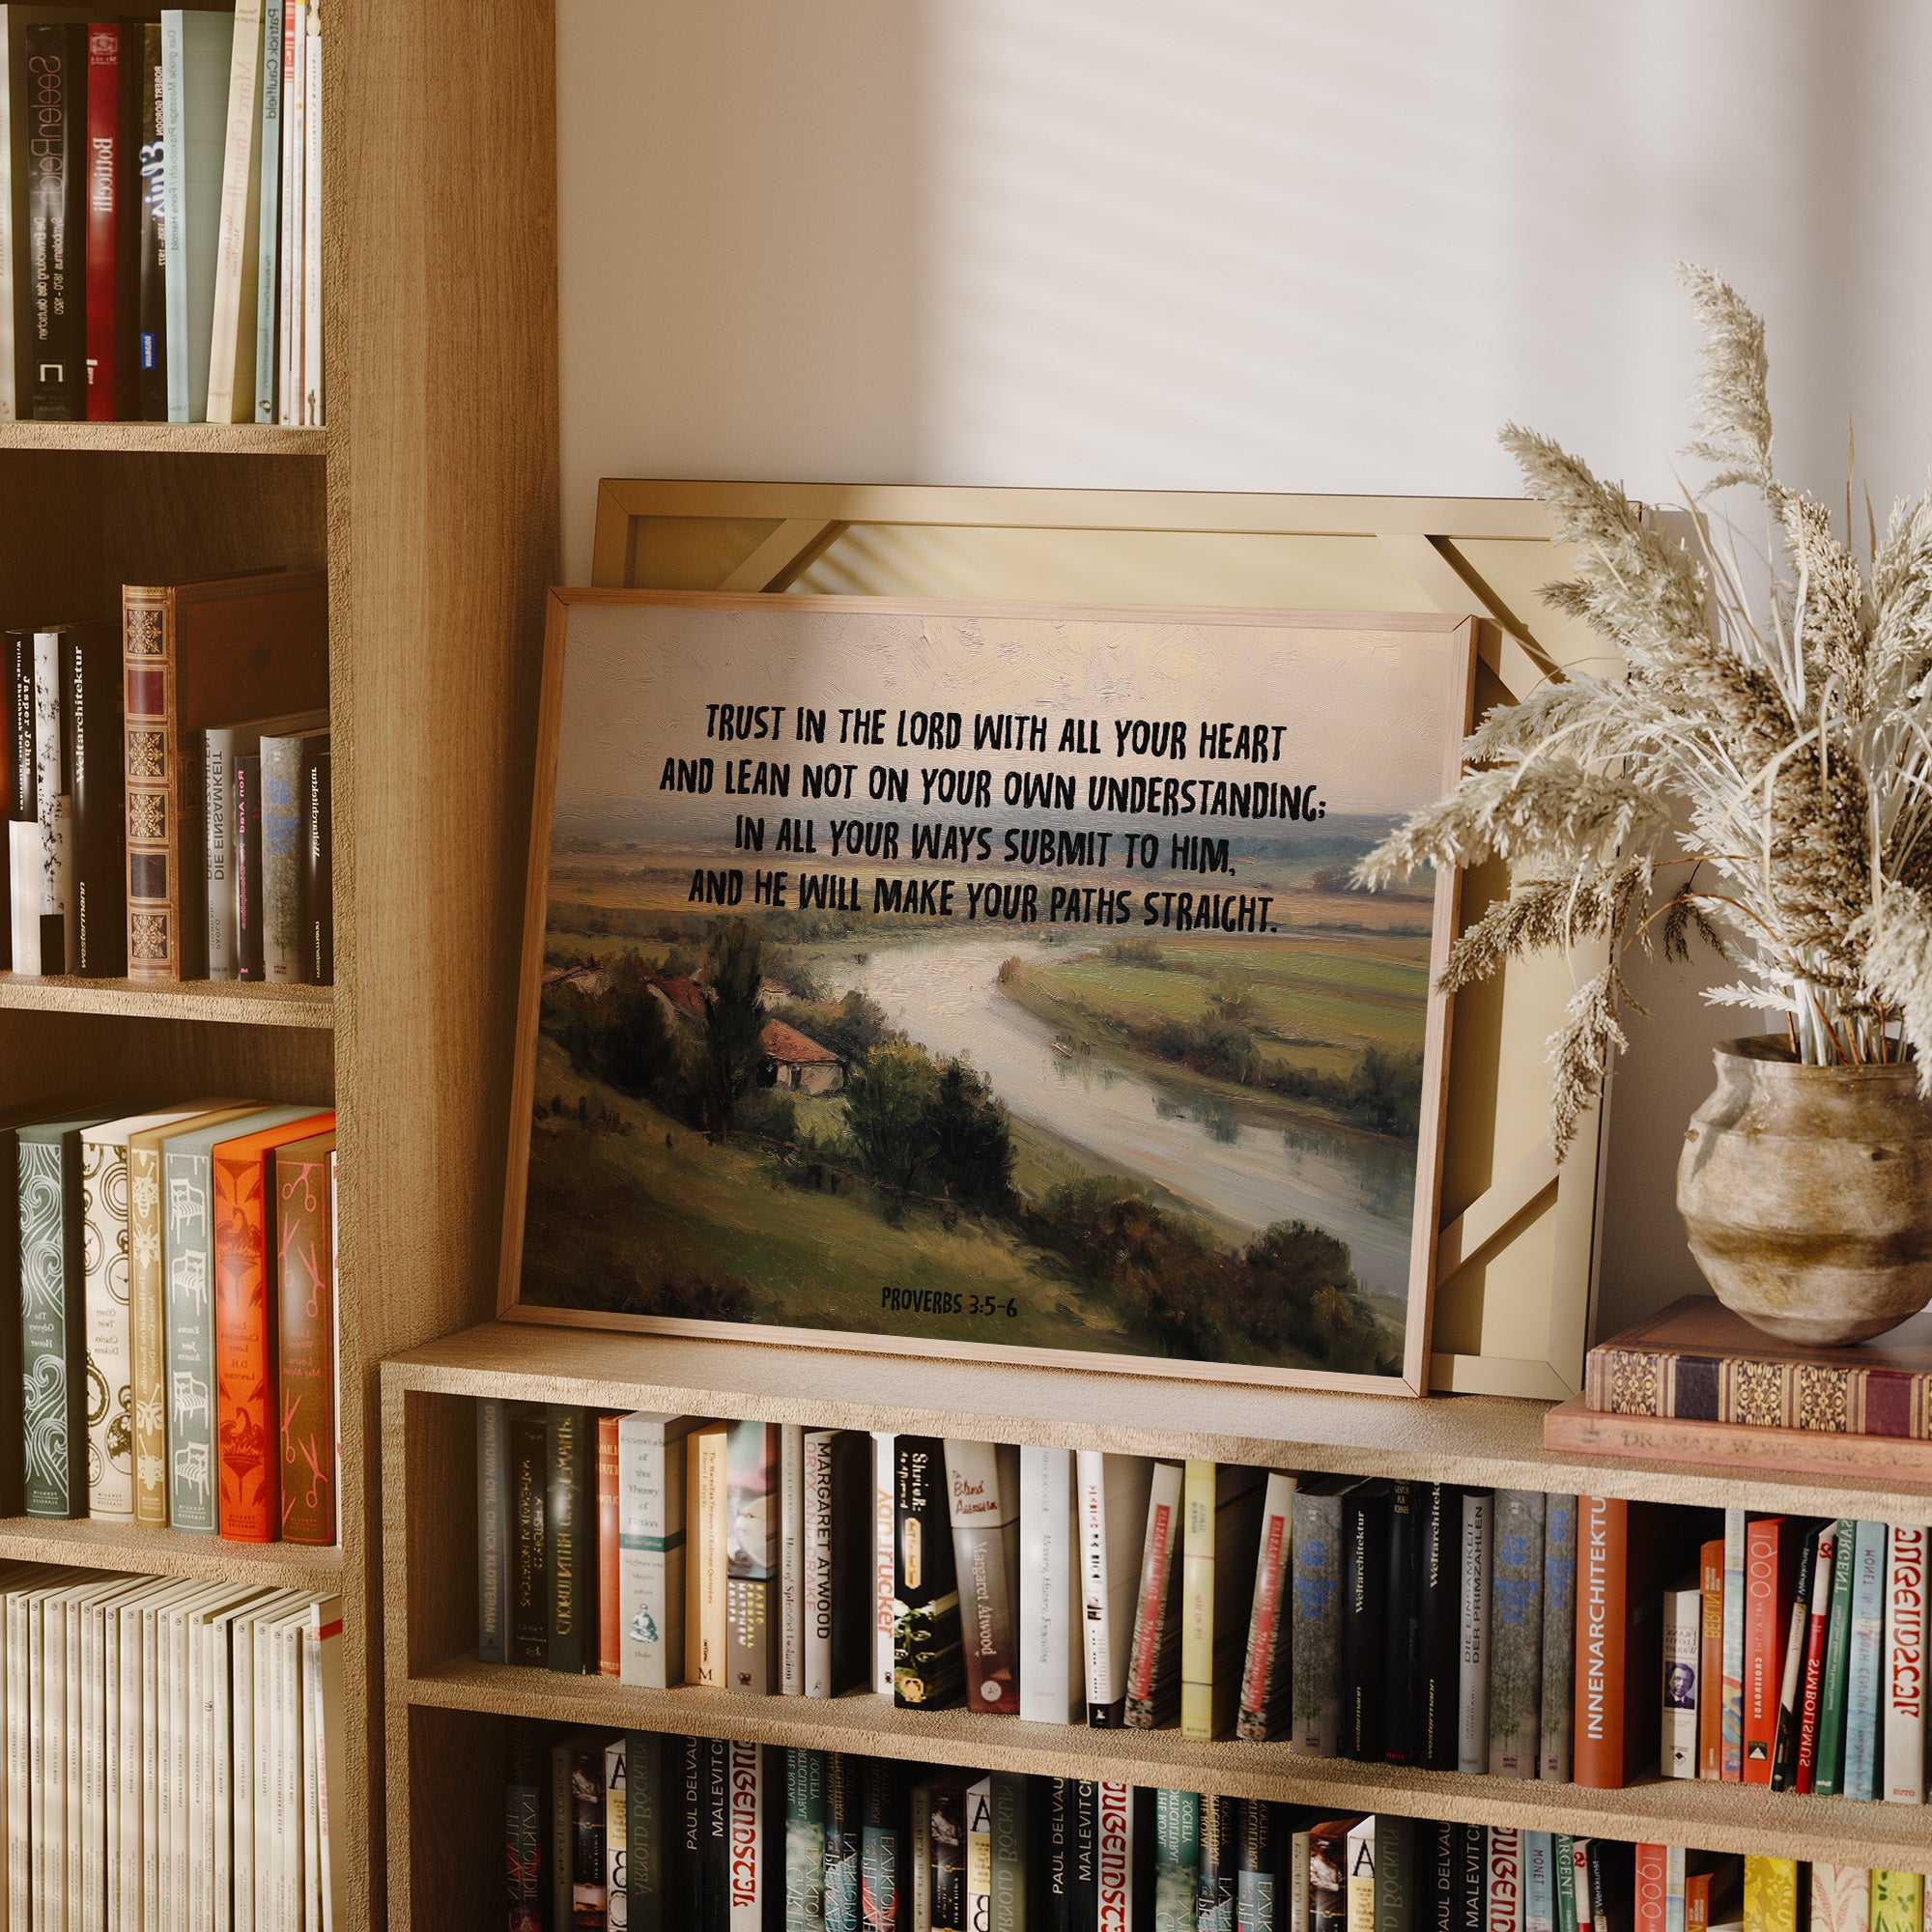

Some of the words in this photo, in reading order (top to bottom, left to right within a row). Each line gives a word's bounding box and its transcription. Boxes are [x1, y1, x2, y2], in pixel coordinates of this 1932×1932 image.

[22, 676, 31, 726] Jasper
[74, 645, 84, 783] Weltarchitektur
[706, 704, 785, 741] TRUST
[796, 707, 826, 744] IN
[838, 708, 887, 745] THE
[896, 709, 961, 750] LORD
[974, 714, 1047, 753] WITH
[1059, 718, 1101, 753] ALL
[1115, 721, 1186, 759] YOUR
[1199, 722, 1287, 763] HEART
[659, 757, 714, 794] AND
[724, 759, 790, 798] LEAN
[801, 763, 858, 799] NOT
[868, 765, 908, 803] ON
[922, 768, 991, 808] YOUR
[1004, 771, 1076, 810] OWN
[1088, 776, 1326, 822] UNDERSTANDING;
[735, 814, 764, 851] IN
[776, 817, 816, 853] ALL
[831, 819, 899, 860] YOUR
[912, 822, 992, 863] WAYS
[1004, 828, 1113, 867] SUBMIT
[1125, 833, 1158, 868] TO
[1171, 833, 1236, 876] HIM,
[688, 869, 743, 906] AND
[754, 869, 787, 907] HE
[799, 872, 862, 911] WILL
[873, 877, 955, 915] MAKE
[967, 882, 1037, 923] YOUR
[1050, 886, 1132, 924] PATHS
[1144, 891, 1277, 933] STRAIGHT.
[882, 1287, 962, 1314] PROVERBS
[969, 1294, 1018, 1318] 3:5-6
[485, 1405, 497, 1476] DOWNTOWN
[639, 1452, 647, 1463] of
[805, 1441, 817, 1489] ORYX
[485, 1479, 497, 1505] OWL
[629, 1486, 659, 1496] Theory
[636, 1469, 651, 1478] the
[817, 1442, 831, 1551] MARGARET
[485, 1510, 497, 1551] CHUCK
[628, 1518, 659, 1528] Fiction
[639, 1502, 648, 1511] of
[805, 1497, 817, 1541] AND
[805, 1550, 817, 1611] CRAKE
[972, 1541, 989, 1601] Margaret
[1355, 1511, 1365, 1613] Weltarchitektur
[1473, 1506, 1483, 1622] PRIMZAHLEN
[485, 1555, 497, 1634] KLOSTERMAN
[816, 1556, 831, 1639] ATWOOD
[1587, 1495, 1606, 1740] INNENARCHITEKTU
[978, 1604, 996, 1657] Atwood
[697, 1667, 713, 1681] M
[1427, 1679, 1435, 1759] westermann
[686, 1807, 697, 1851] PAUL
[1052, 1777, 1064, 1845] DELVAU
[1052, 1851, 1064, 1894] PAUL
[1533, 1849, 1544, 1886] MONET
[1557, 1834, 1574, 1899] ARGENT
[1592, 1861, 1604, 1907] Werkkunst
[1636, 1856, 1662, 1918] 1900
